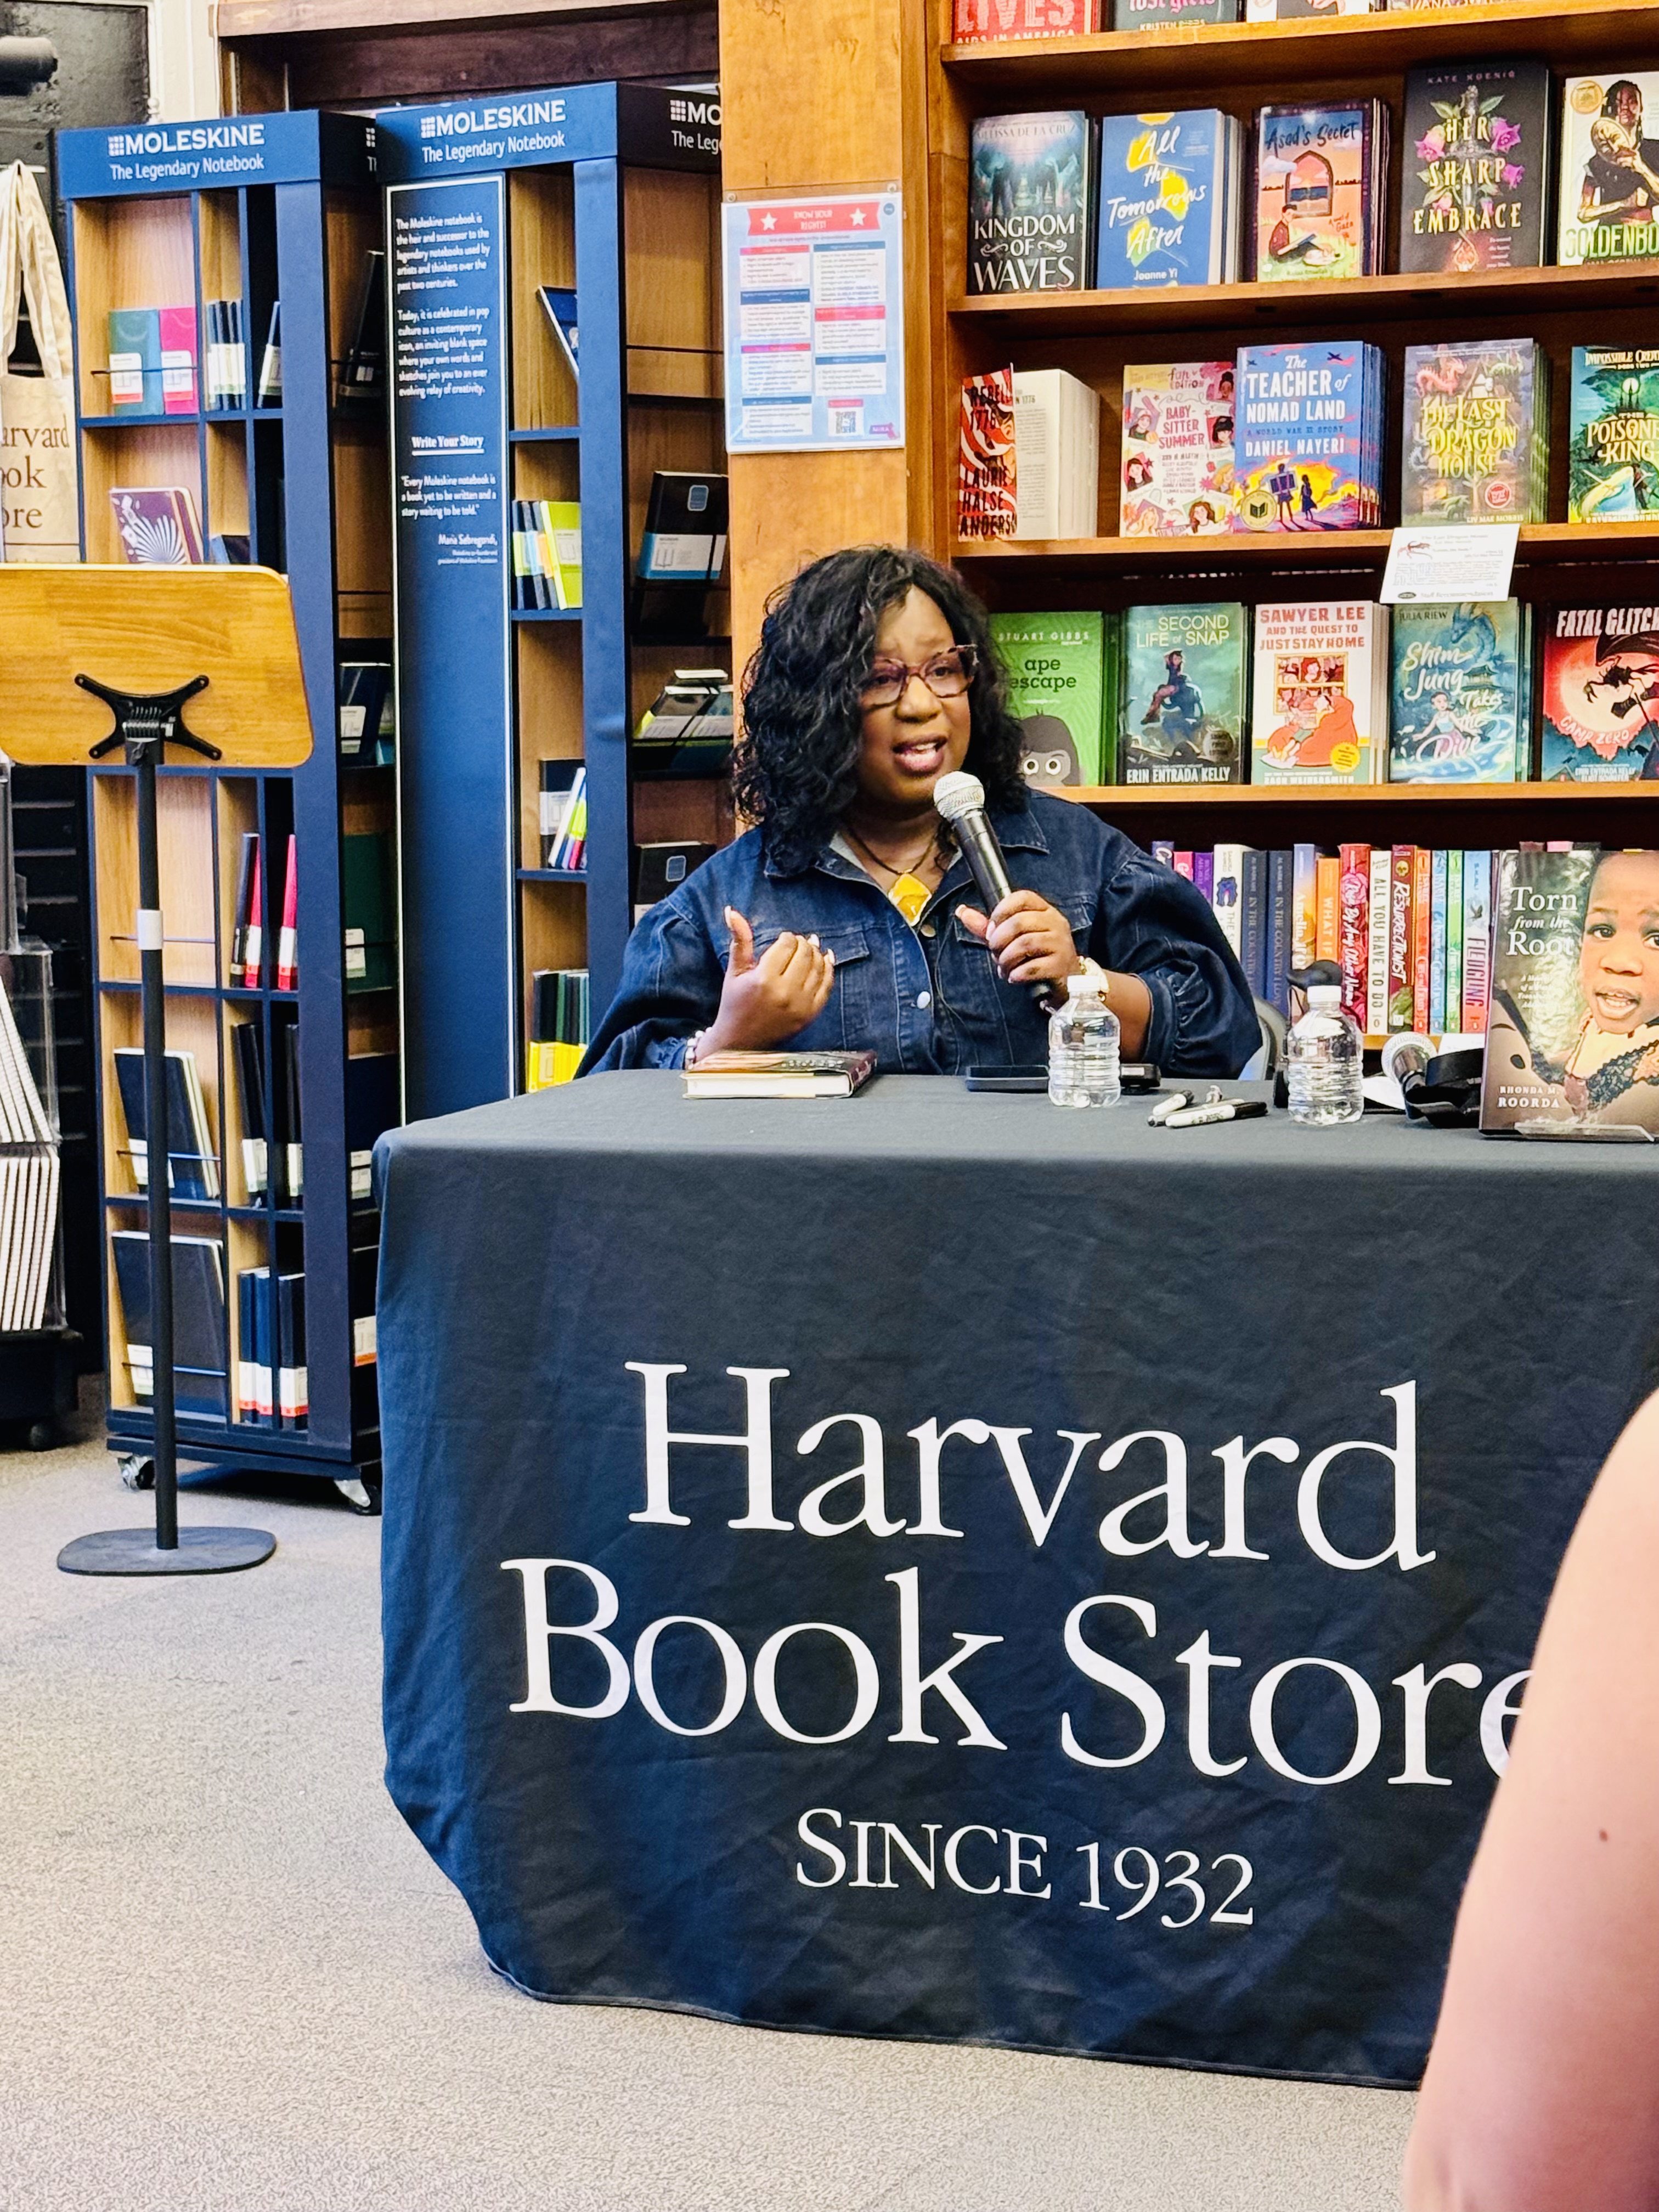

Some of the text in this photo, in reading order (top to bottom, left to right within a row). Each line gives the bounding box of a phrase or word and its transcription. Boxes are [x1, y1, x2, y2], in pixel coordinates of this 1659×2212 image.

[1428, 71, 1515, 83] KATE KOENIG
[436, 99, 566, 136] MOLESKINE
[1446, 116, 1490, 143] HER
[125, 125, 264, 155] MOLESKINE
[673, 130, 695, 148] The
[1018, 127, 1030, 137] DE
[1138, 126, 1181, 162] All
[1266, 122, 1359, 158] Asad's Secret
[422, 131, 566, 164] The Legendary Notebook
[111, 154, 264, 183] The Legendary Notebook
[1143, 164, 1170, 187] the
[1429, 158, 1506, 188] SHARP
[1107, 185, 1206, 229] Tomorrows
[1413, 202, 1522, 235] EMBRACE
[396, 218, 409, 230] The
[975, 213, 1075, 239] KINGDOM
[1010, 238, 1035, 256] OF
[1126, 225, 1184, 258] After
[974, 256, 1075, 292] WAVES
[1133, 269, 1167, 281] Joanne
[1284, 355, 1307, 369] The
[1585, 352, 1633, 366] IMPOSSIBLE
[1246, 370, 1352, 399] TEACHER of
[1166, 405, 1196, 420] BABY-
[1246, 400, 1346, 424] NOMAD LAND
[1421, 395, 1511, 428] THE LAST
[2, 413, 70, 448] arvard
[1163, 419, 1199, 435] SITTER
[412, 434, 484, 449] Write Your Story
[1159, 433, 1205, 449] SUMMER
[1246, 438, 1344, 458] DANIEL NAYERI
[1427, 426, 1518, 455] DRAGON
[1597, 440, 1656, 466] KING
[1437, 454, 1498, 478] HOUSE
[962, 490, 1003, 512] HALSE
[1159, 614, 1229, 631] SECOND
[1260, 607, 1365, 623] SAWYER LEE
[1400, 611, 1448, 623] JULIA RIEW
[1556, 609, 1602, 637] FATAL
[999, 631, 1090, 641] STUART GIBBS
[1136, 632, 1169, 648] LIFE
[1186, 630, 1229, 646] SNAP
[1266, 624, 1358, 635] AND THE QUEST TO
[1260, 636, 1365, 651] JUST STAY HOME
[1025, 658, 1060, 675] ape
[1402, 641, 1474, 671] Shim
[1011, 676, 1077, 692] escape
[1403, 668, 1464, 701] Jung
[1460, 691, 1504, 711] Takes
[1560, 715, 1629, 744] CAMP ZERO
[1415, 733, 1486, 762] Dive
[1126, 766, 1231, 783] ERIN ENTRADA KELLY
[1275, 897, 1284, 907] IN
[1510, 887, 1578, 911] Torn
[1227, 912, 1235, 930] THE
[1274, 910, 1284, 929] THE
[1322, 896, 1334, 955] WHAT IF
[1342, 906, 1359, 923] By
[1513, 915, 1570, 931] from the
[1342, 923, 1361, 946] Any
[1372, 878, 1387, 1008] ALL YOU HAVE TO DO
[1392, 880, 1410, 984] RESURRECTIONIST
[1506, 931, 1573, 956] Root
[1273, 930, 1283, 975] COUNTRY
[1344, 947, 1359, 976] Other
[1465, 937, 1486, 1007] FLEDGLING
[1345, 976, 1359, 1007] Name
[1499, 1085, 1543, 1094] RHONDA
[1498, 1097, 1560, 1108] ROORDA
[624, 1361, 1436, 1573] Harvard
[500, 1556, 1007, 1753] Book
[795, 1809, 1255, 1928] SINCE 1932
